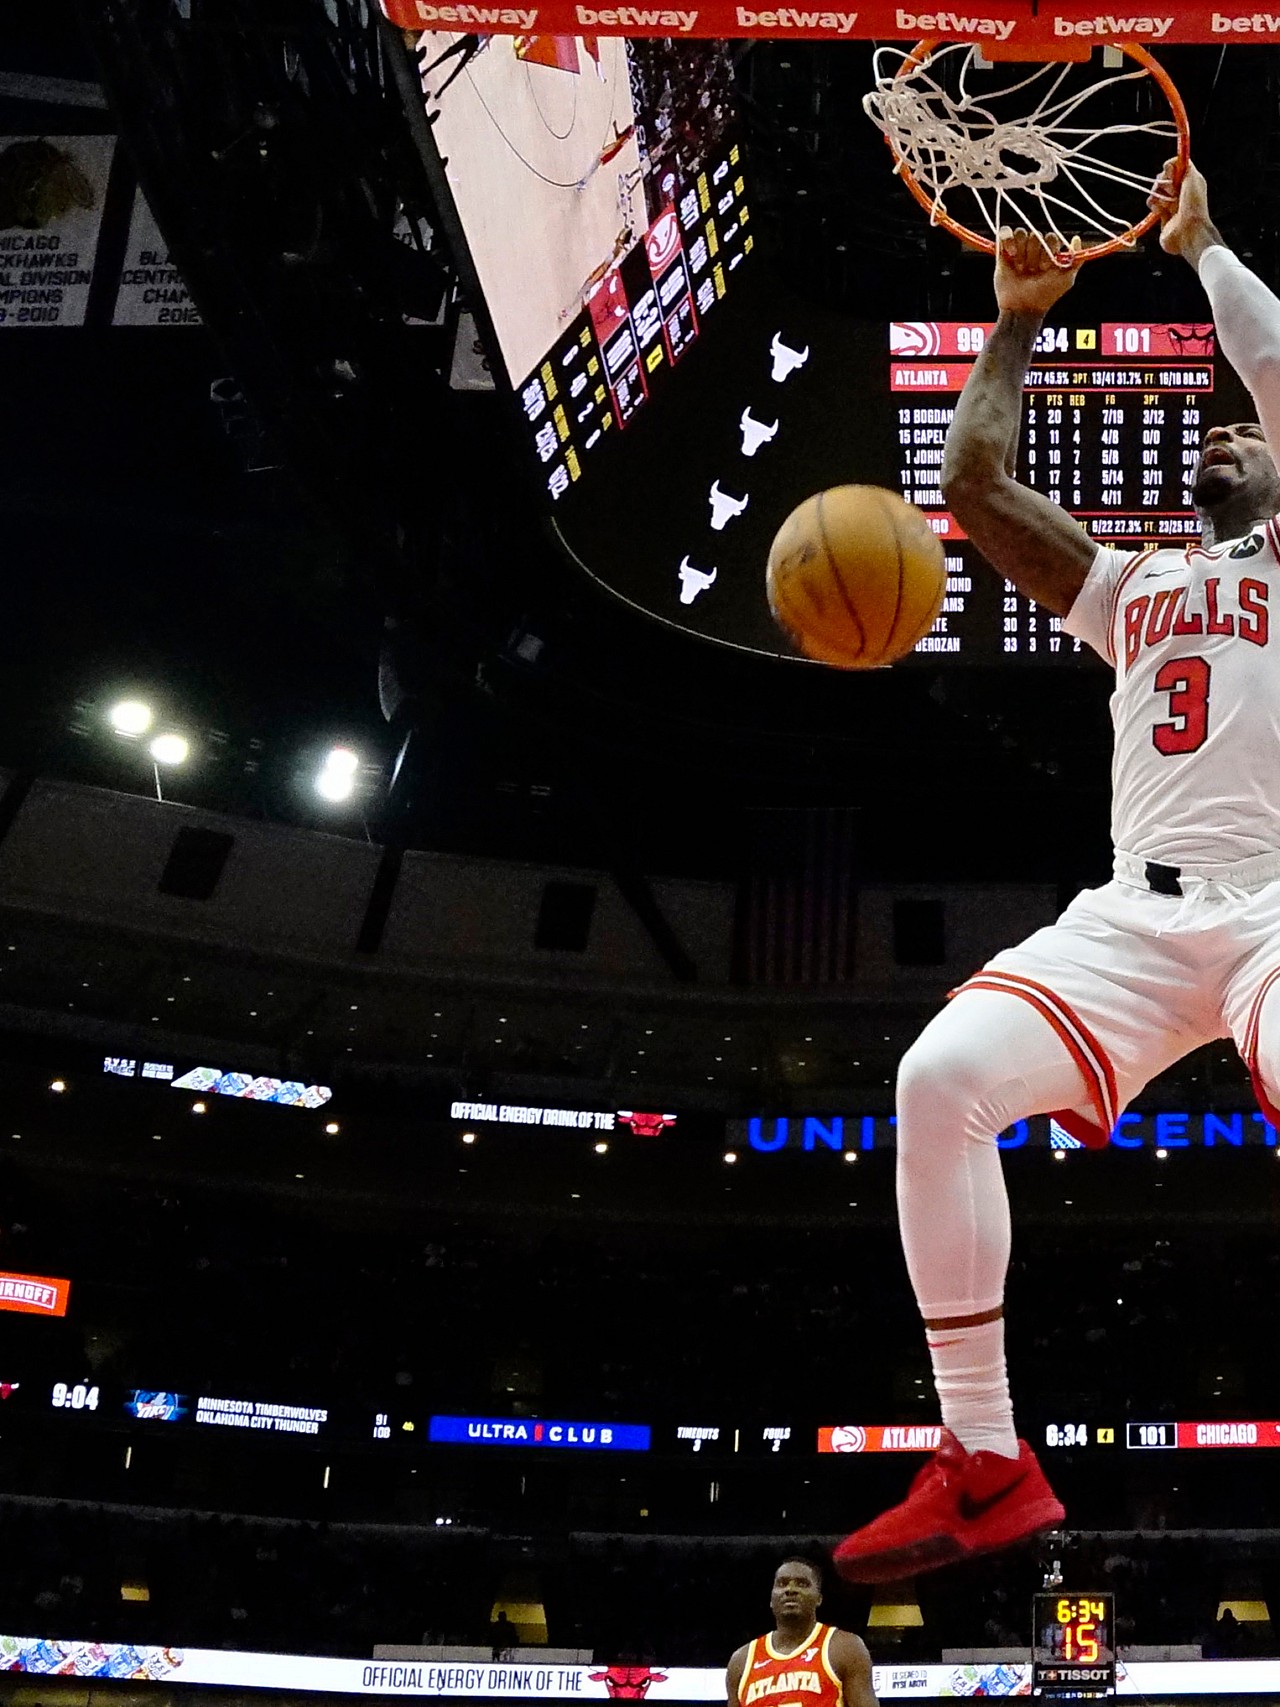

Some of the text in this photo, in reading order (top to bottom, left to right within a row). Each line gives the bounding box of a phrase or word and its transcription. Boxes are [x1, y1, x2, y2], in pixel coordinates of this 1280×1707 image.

[418, 1, 537, 28] betway
[577, 5, 698, 31] betway
[737, 7, 857, 33] betway
[897, 9, 1016, 40] betway
[1054, 14, 1174, 37] betway
[20, 270, 91, 285] DIVISION
[957, 328, 984, 352] 99
[1082, 333, 1091, 347] 4
[1114, 328, 1150, 352] 101
[895, 370, 948, 385] ATLANTA
[1092, 372, 1115, 387] 13/41
[1117, 372, 1141, 386] 31.7%
[1030, 395, 1196, 406] F PTS REB FG 3PT FT
[899, 409, 910, 423] 13
[1029, 410, 1035, 424] 2
[1048, 410, 1061, 424] 20
[1074, 410, 1080, 424] 3
[1102, 409, 1123, 424] 7/19
[1143, 409, 1164, 424] 3/12
[1183, 410, 1199, 424] 3/3
[899, 429, 1199, 445] 15 CAPEL 3 11 4 4/8 0/0 3/4
[905, 450, 910, 464] 1
[1029, 450, 1036, 464] 0
[1049, 450, 1060, 464] 10
[1074, 450, 1080, 464] 7
[1102, 449, 1119, 464] 5/8
[1143, 450, 1157, 464] 0/1
[901, 470, 910, 484] 11
[1030, 470, 1034, 484] 1
[1049, 470, 1060, 484] 17
[1073, 470, 1080, 484] 2
[1102, 470, 1123, 485] 5/14
[1143, 469, 1162, 485] 3/11
[904, 490, 911, 504] 5
[914, 490, 946, 504] MURR
[1074, 490, 1080, 504] 6
[1102, 490, 1121, 505] 4/11
[1143, 490, 1159, 505] 2/7
[1092, 520, 1182, 534] 6/22 27.3% 23/25
[1004, 598, 1017, 612] 23
[1004, 618, 1017, 632] 30
[1030, 618, 1036, 632] 2
[1125, 577, 1268, 677] BULLS
[1004, 638, 1017, 652] 33
[1030, 638, 1036, 652] 3
[1050, 638, 1060, 652] 17
[1073, 638, 1080, 652] 2
[1153, 656, 1211, 756] 3
[451, 1102, 615, 1130] OFFICIAL ENERGY DRINK OF THE
[52, 1383, 99, 1410] 9:04
[198, 1397, 328, 1422] MINNESOTA TIMBERWOLVES
[196, 1410, 318, 1434] OKLAHOMA CITY THUNDER
[376, 1414, 388, 1425] 91
[468, 1424, 613, 1444] ULTRA CLUB
[677, 1427, 719, 1440] TIMEOUTS
[763, 1427, 791, 1440] FOULS
[1046, 1423, 1088, 1447] 6:34
[1100, 1430, 1108, 1442] 4
[1139, 1426, 1166, 1445] 101
[1197, 1424, 1257, 1445] CHICAGO
[773, 1440, 780, 1452] 2
[1057, 1600, 1104, 1623] 6:34
[1065, 1624, 1099, 1662] 15
[362, 1666, 583, 1692] OFFICIAL ENERGY DRINK OF THE
[1057, 1670, 1110, 1680] TISSOT
[746, 1671, 821, 1705] ATLANTA
